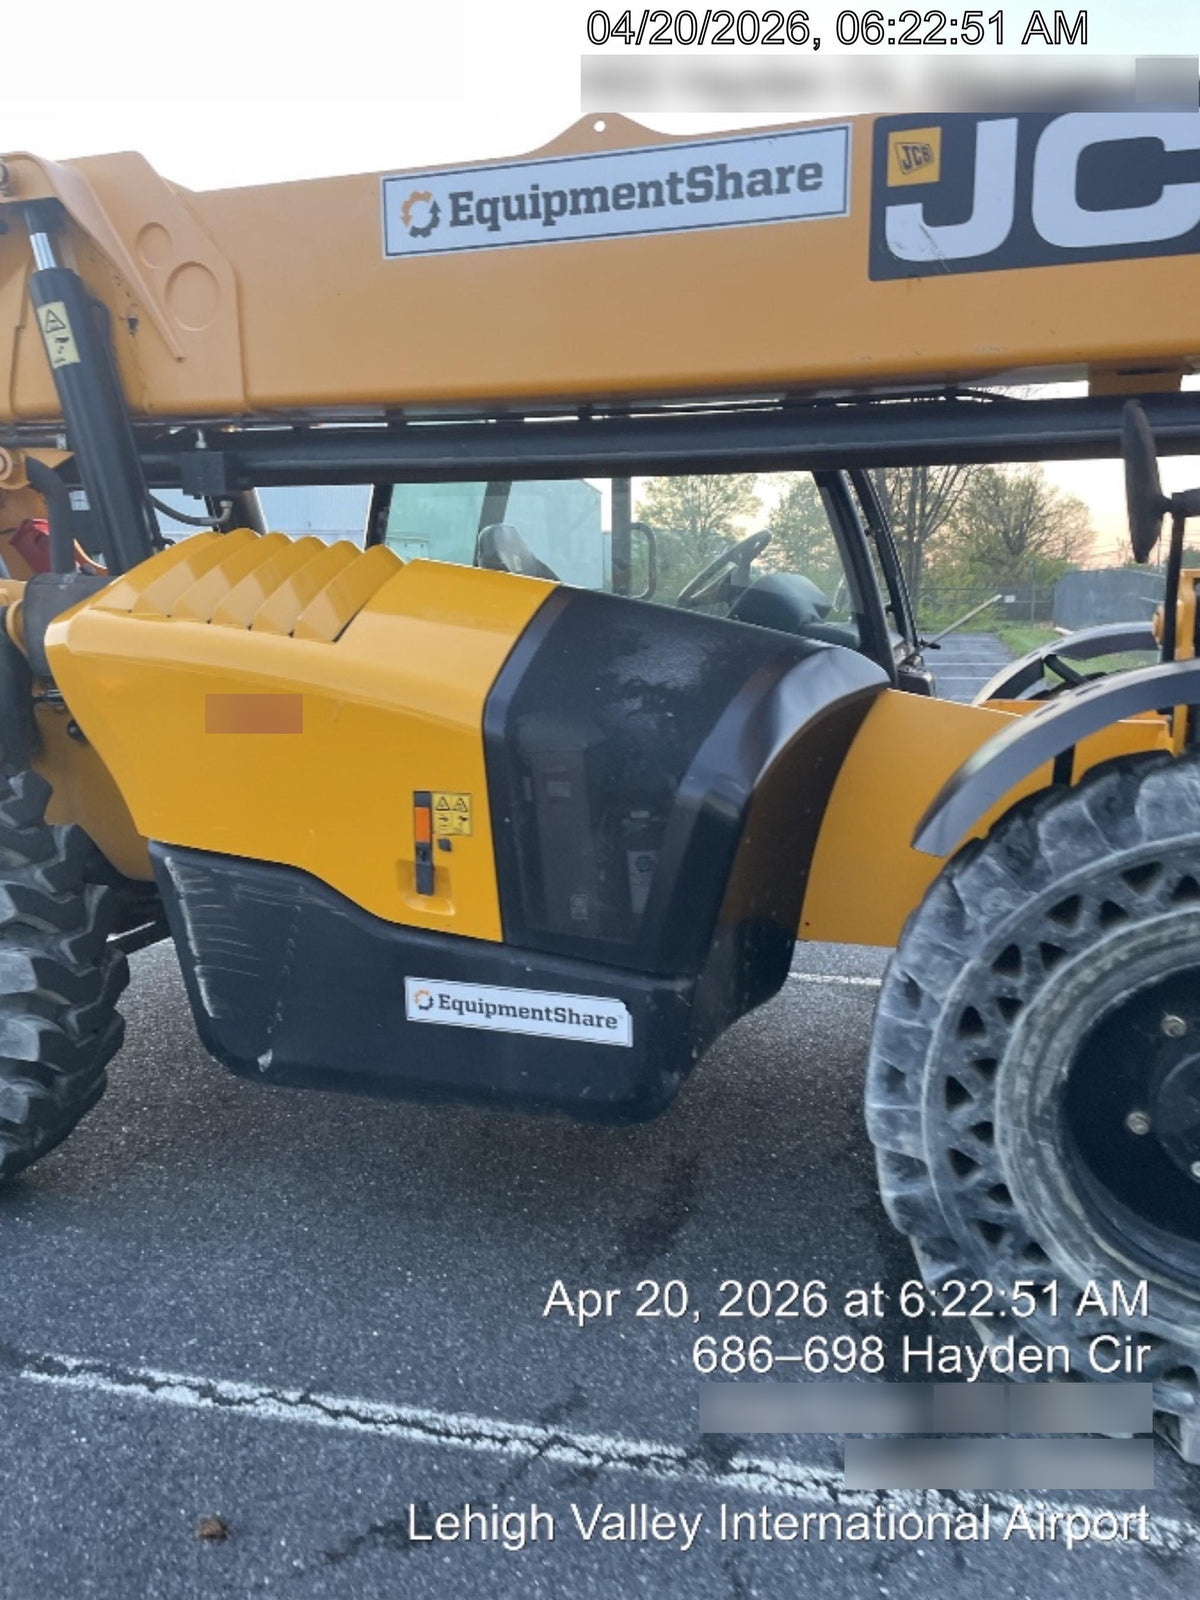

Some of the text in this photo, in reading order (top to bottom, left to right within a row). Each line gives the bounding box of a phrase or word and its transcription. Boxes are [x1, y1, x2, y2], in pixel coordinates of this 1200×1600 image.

[901, 144, 931, 170] JCB
[448, 161, 824, 232] EquipmentShare
[438, 993, 618, 1030] EquipmentShare
